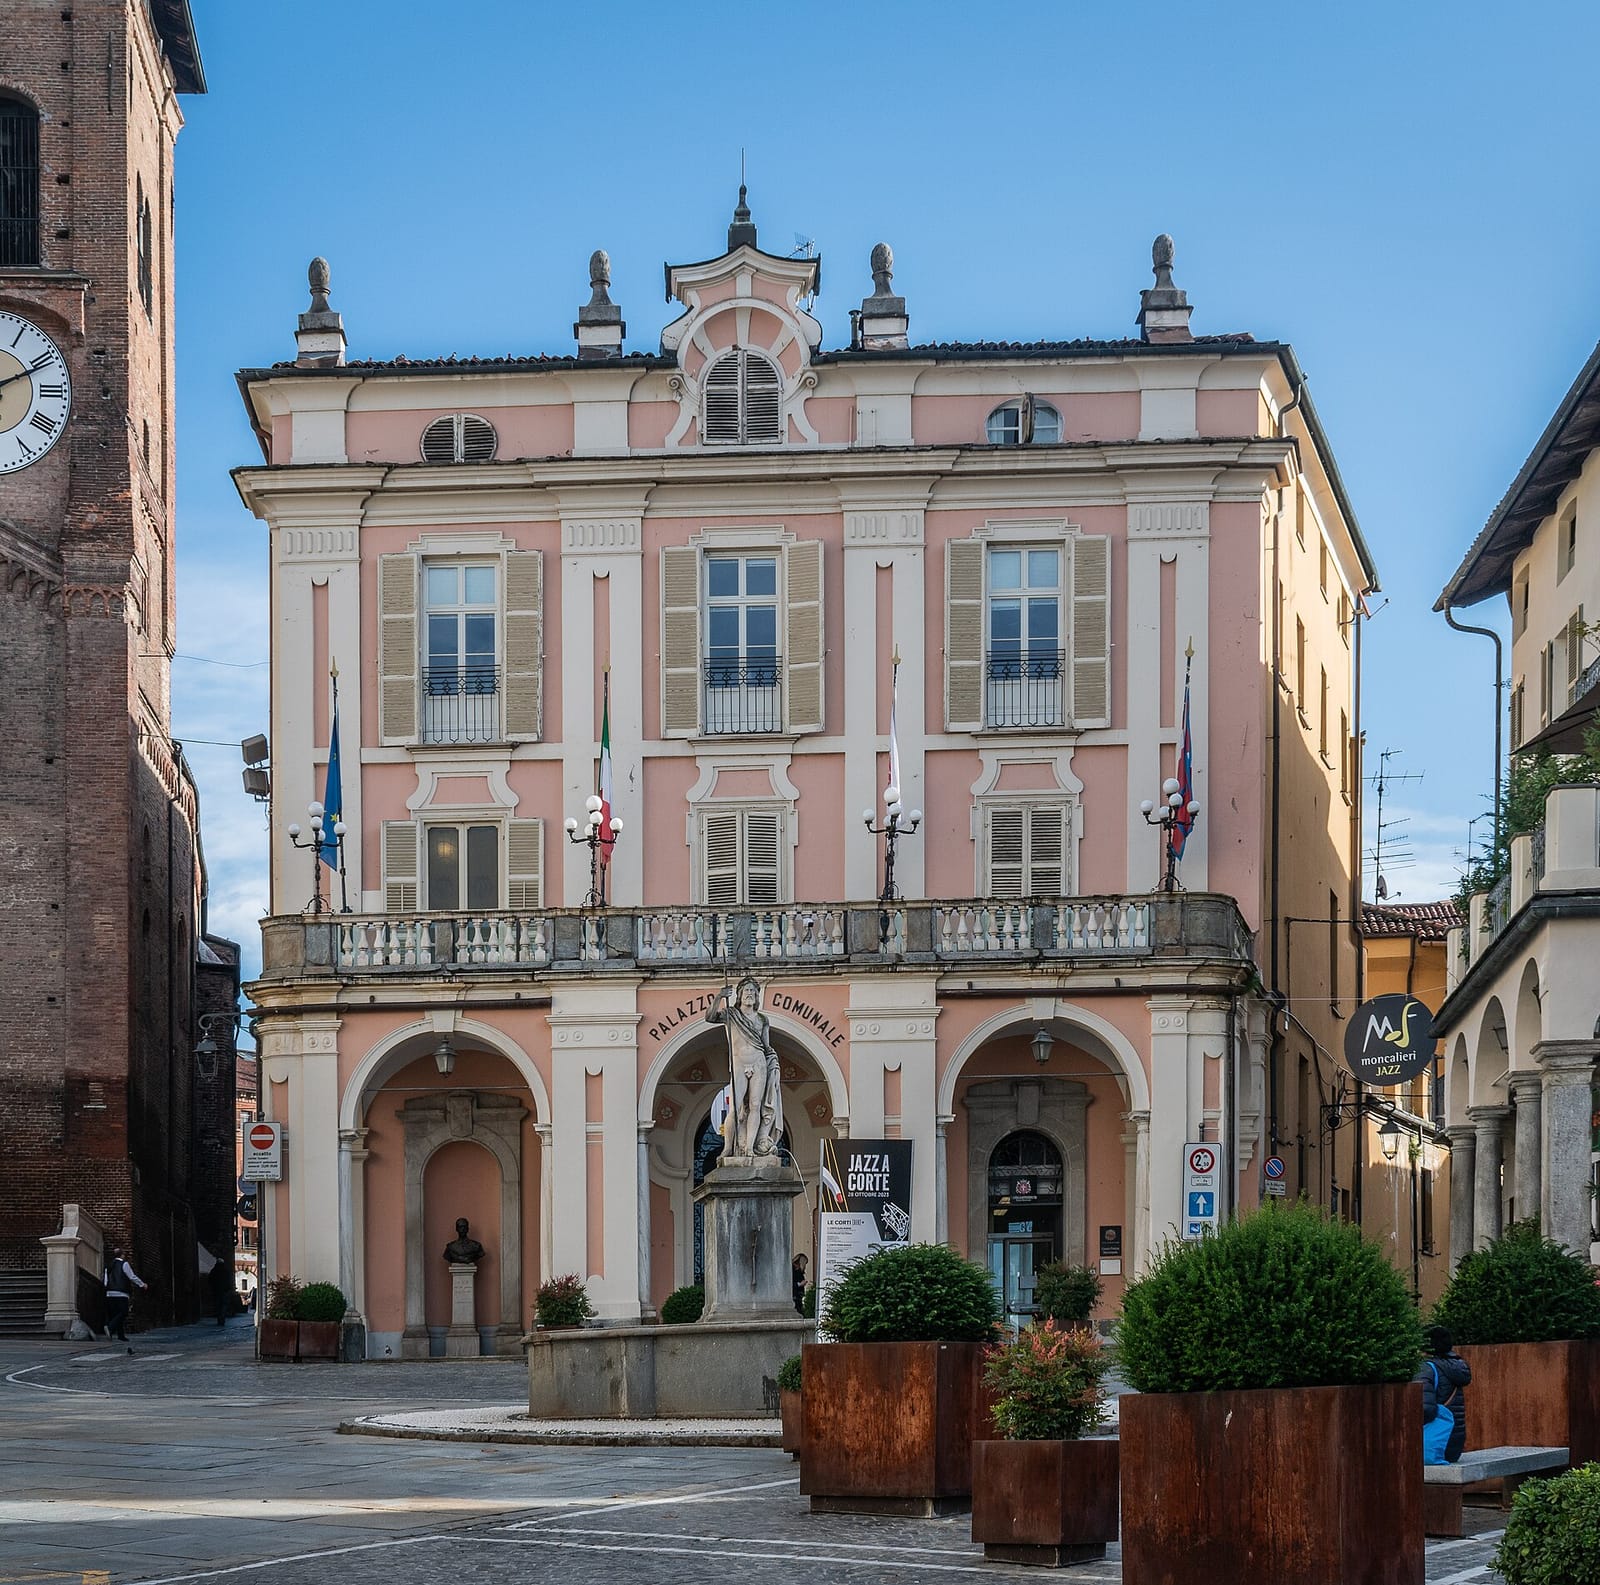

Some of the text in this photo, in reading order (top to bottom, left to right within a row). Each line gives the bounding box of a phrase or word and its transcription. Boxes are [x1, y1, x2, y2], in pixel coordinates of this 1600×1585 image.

[772, 993, 846, 1048] COMUNALE
[1361, 1050, 1417, 1066] moncalieri
[1376, 1065, 1400, 1076] JAZZ
[847, 1154, 890, 1172] JAZZ A
[847, 1173, 890, 1191] CORTE
